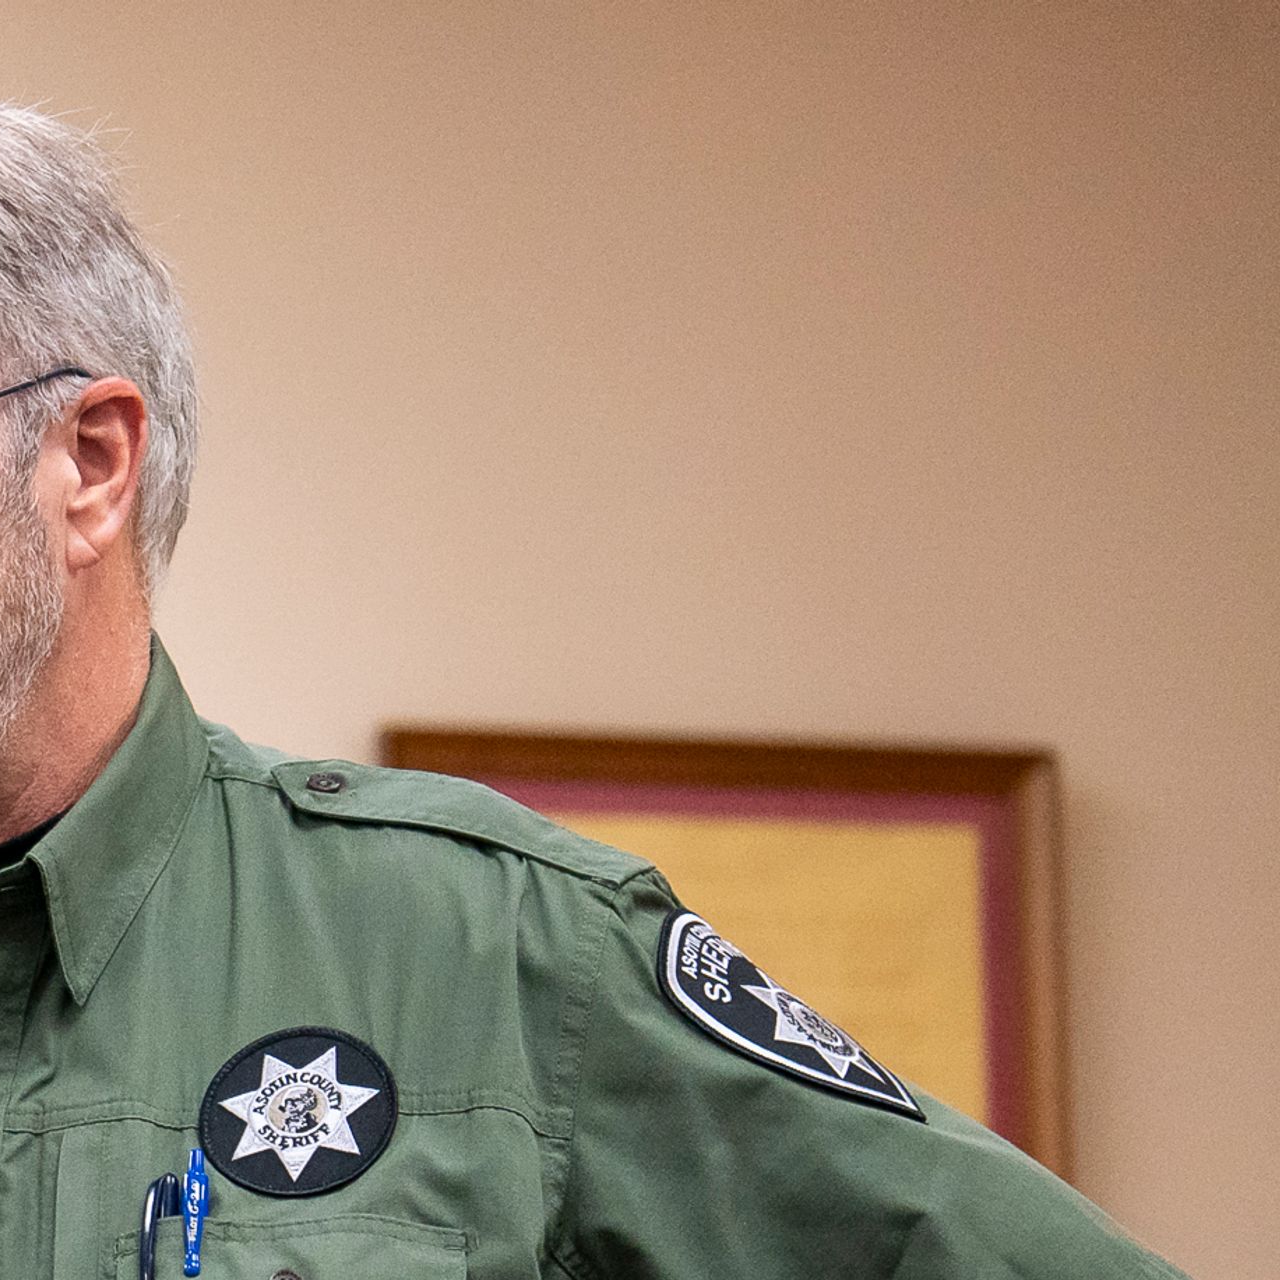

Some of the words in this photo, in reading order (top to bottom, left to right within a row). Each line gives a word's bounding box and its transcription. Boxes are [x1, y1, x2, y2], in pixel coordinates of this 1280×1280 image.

[252, 1072, 298, 1116] ASOTIN
[300, 1072, 342, 1112] COUNTY
[258, 1122, 330, 1151] SHERIFF
